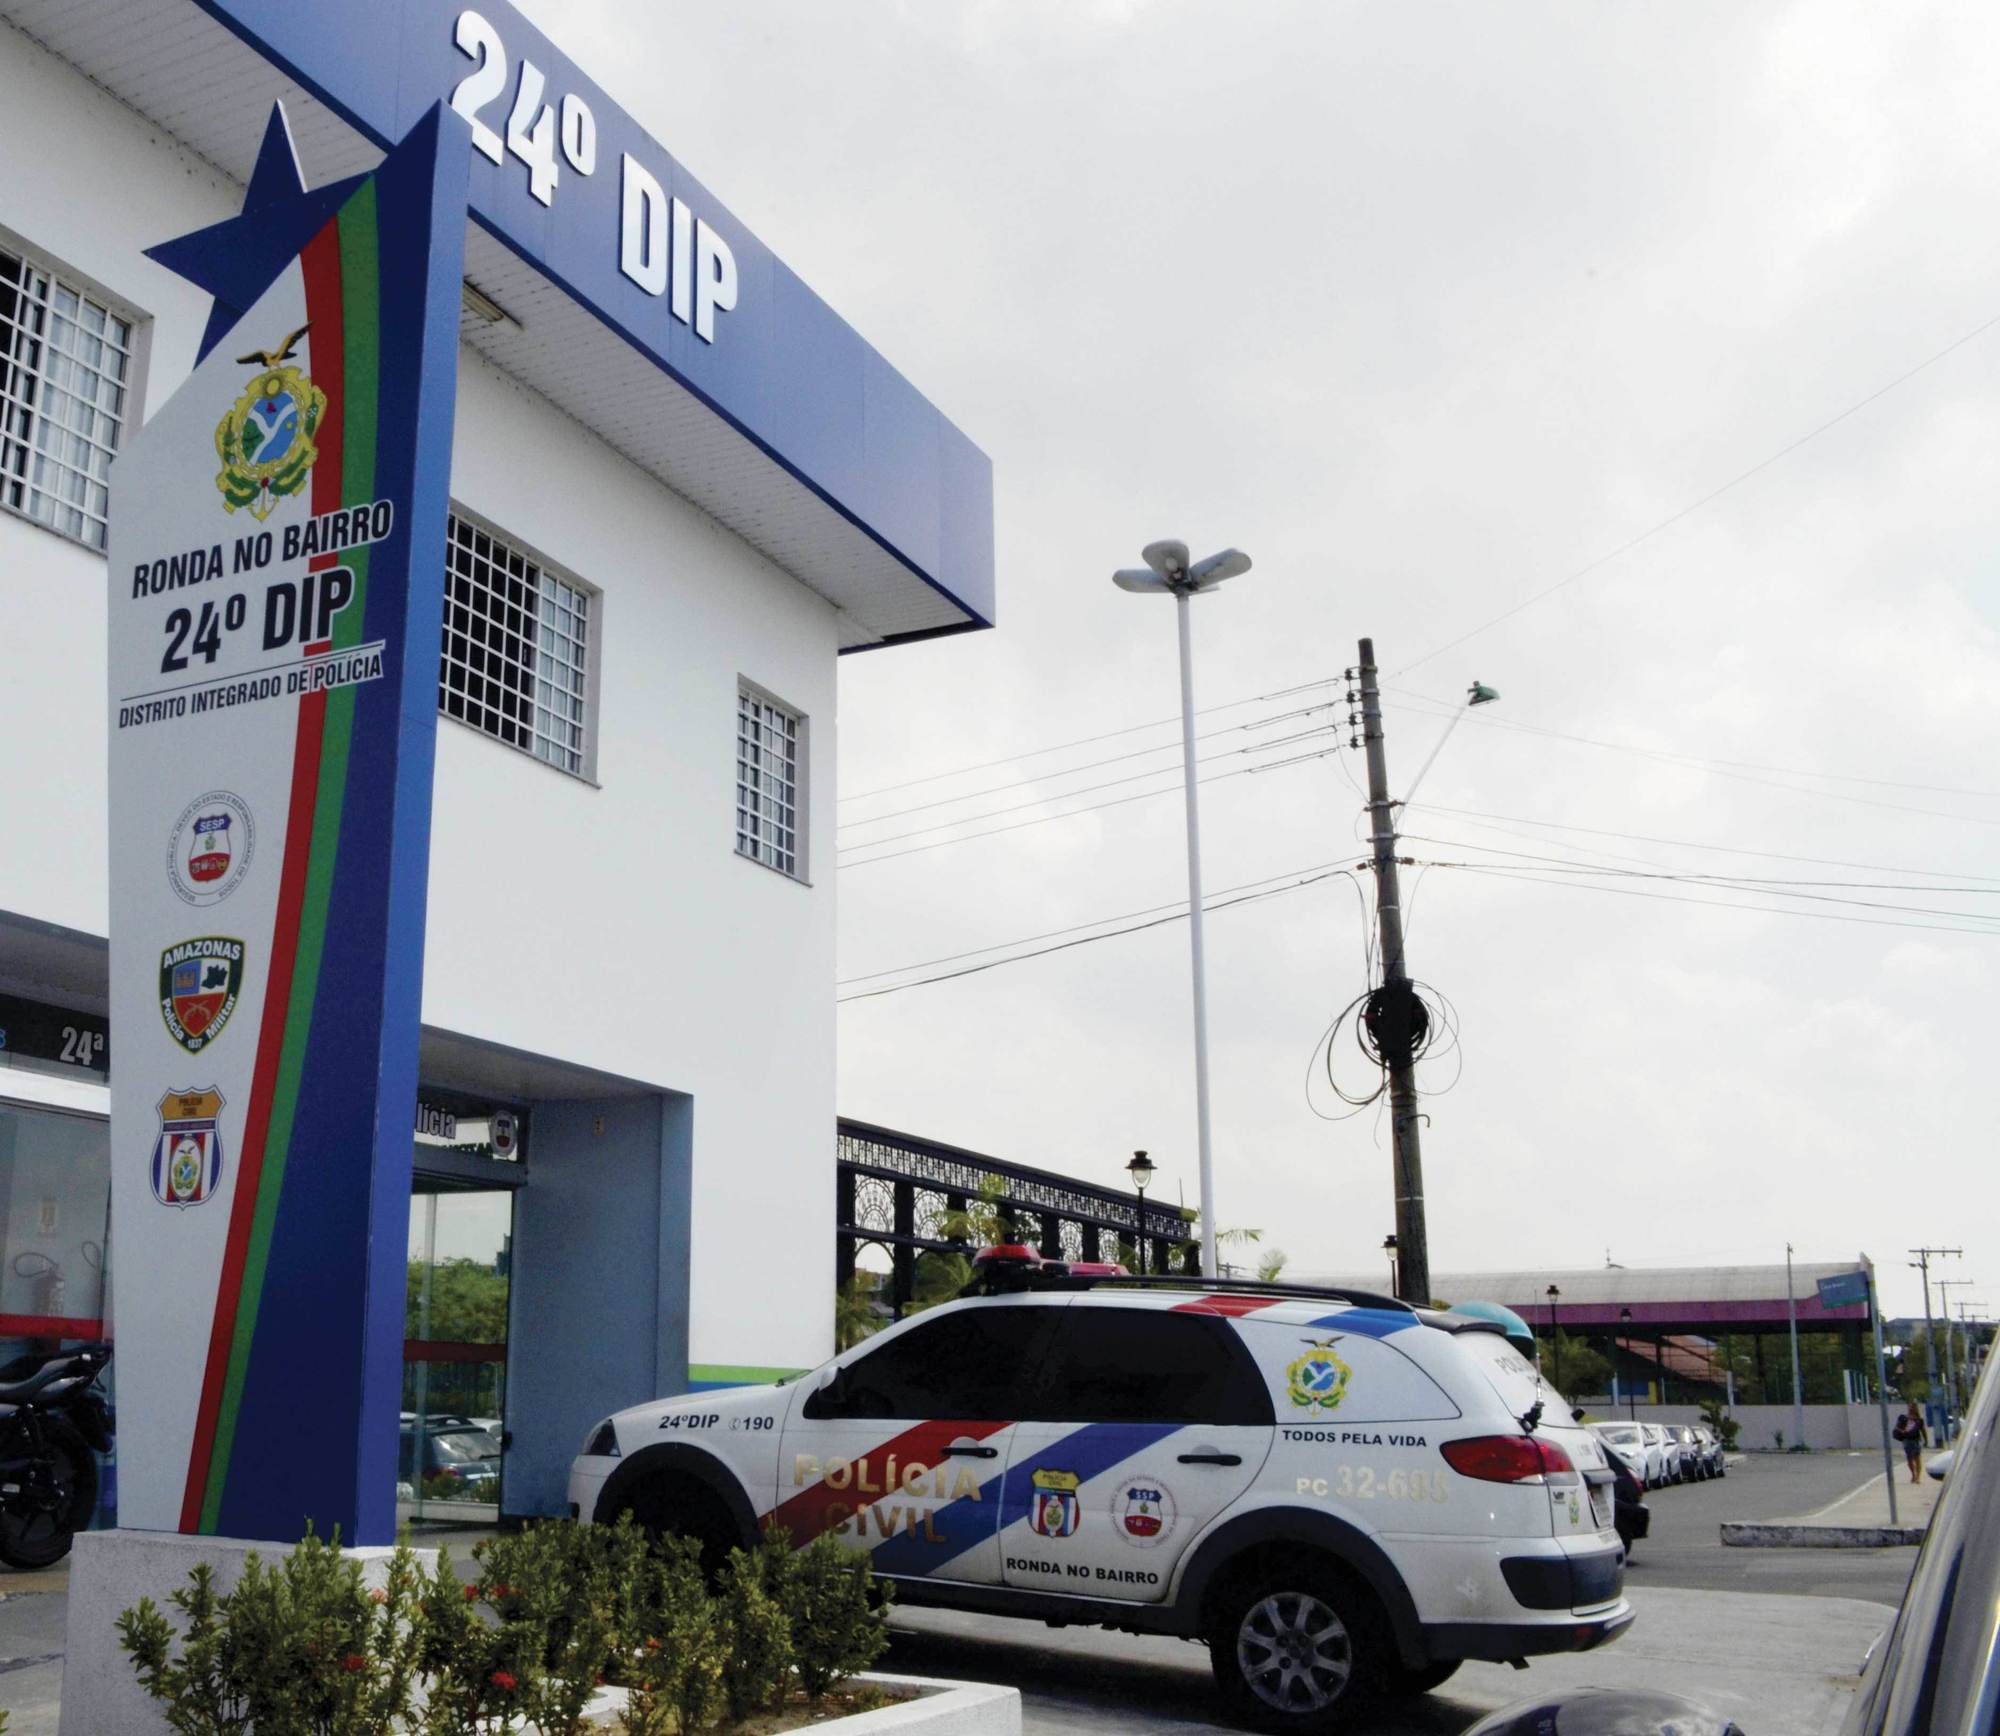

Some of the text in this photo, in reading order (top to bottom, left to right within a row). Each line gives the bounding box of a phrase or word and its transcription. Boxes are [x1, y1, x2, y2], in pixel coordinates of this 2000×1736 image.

[617, 152, 738, 344] DIP
[132, 501, 392, 599] RONDA NO BAIRRO
[262, 569, 352, 651] DIP
[119, 652, 381, 728] DISTRITO INTEGRADO DE POLÍCIA
[200, 818, 225, 831] SESP
[164, 941, 241, 968] AMAZONAS
[743, 1416, 774, 1431] 190
[1282, 1430, 1427, 1447] TODOS PELA VIDA
[793, 1453, 982, 1502] POLÍCIA
[1296, 1477, 1329, 1497] PC
[1135, 1491, 1155, 1500] SSP
[825, 1502, 947, 1544] CIVIL
[1006, 1557, 1159, 1585] RONDA NO BAIRRO
